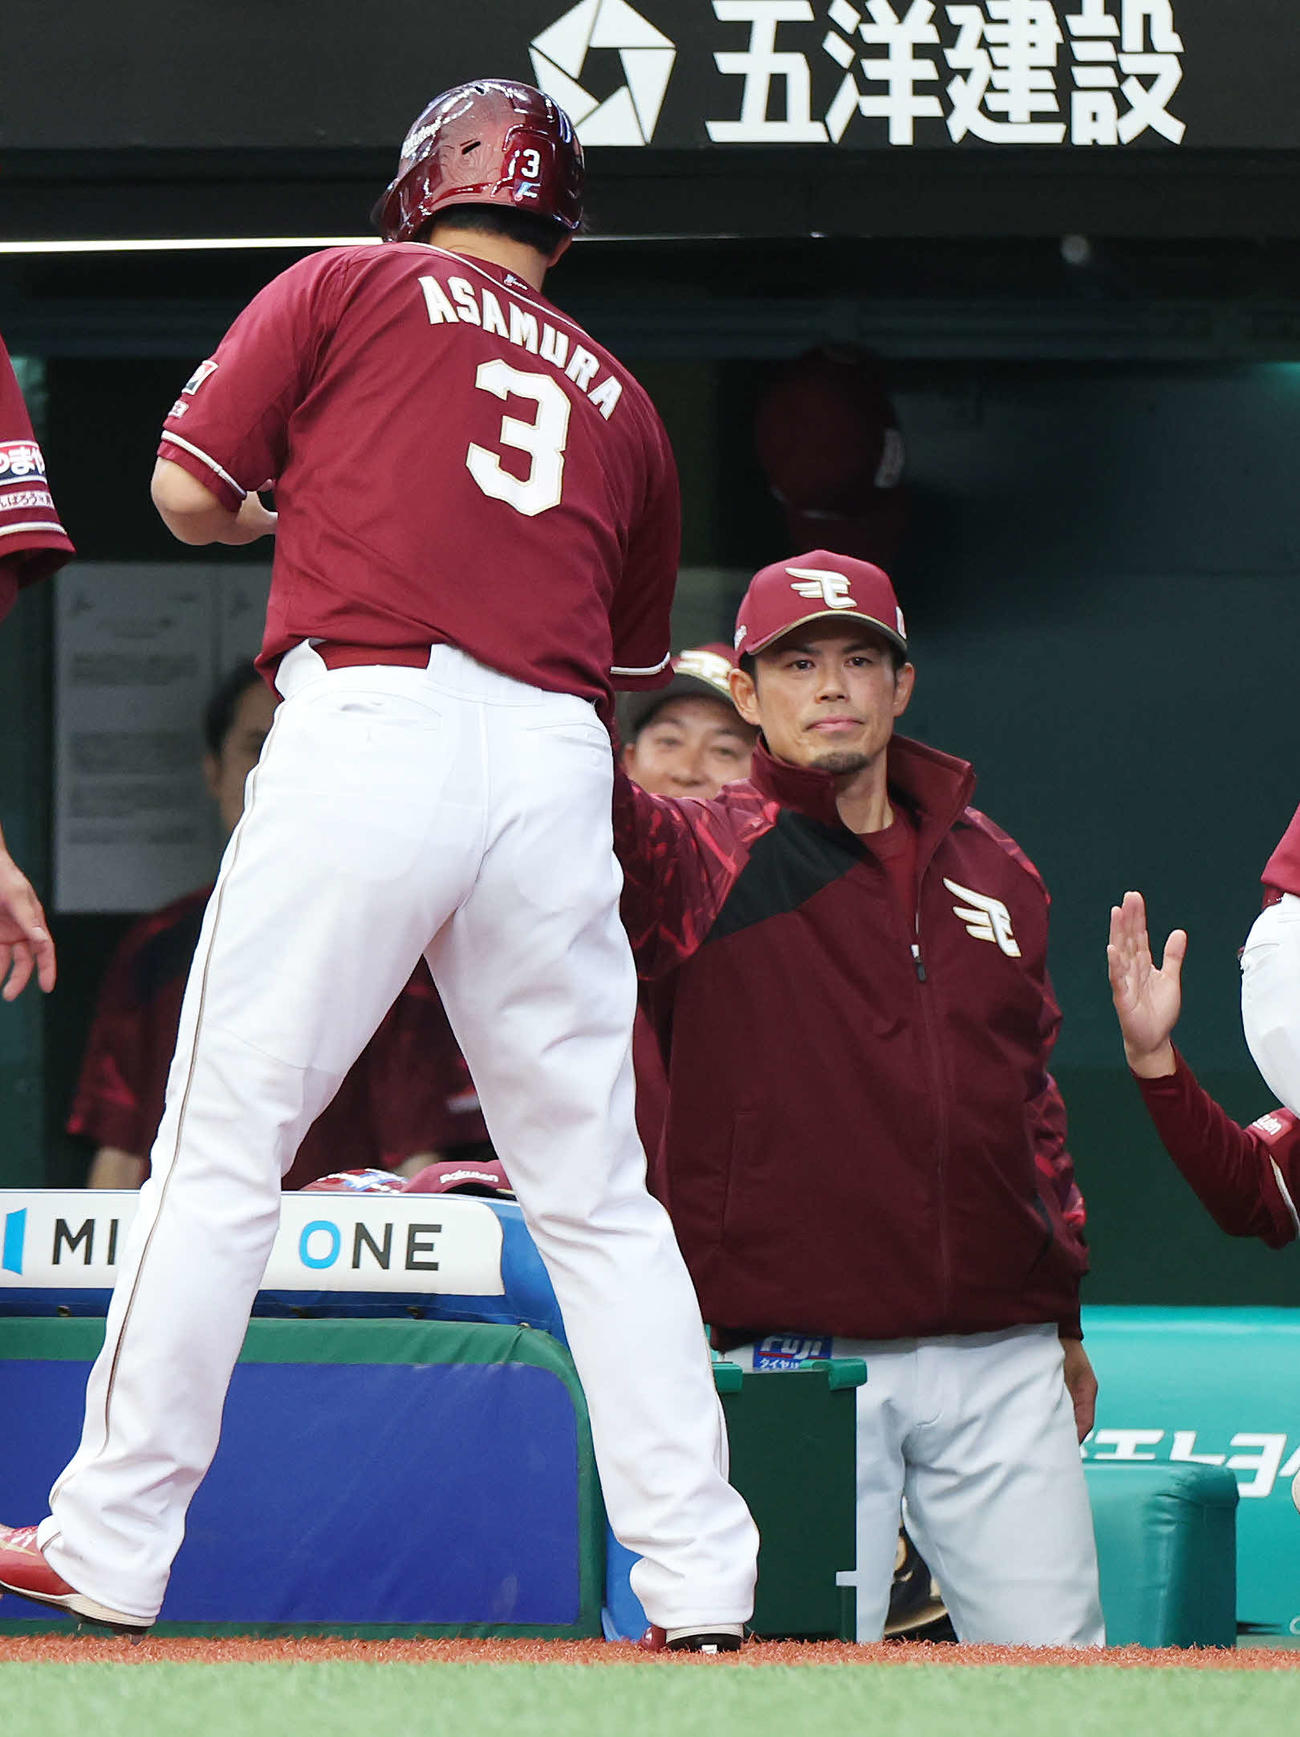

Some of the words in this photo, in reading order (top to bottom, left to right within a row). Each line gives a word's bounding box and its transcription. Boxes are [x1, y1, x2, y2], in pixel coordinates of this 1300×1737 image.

[705, 0, 1186, 145] 五洋建設
[521, 149, 541, 178] 3
[418, 275, 623, 421] ASAMURA
[466, 359, 571, 517] 3
[299, 1219, 442, 1272] ONE
